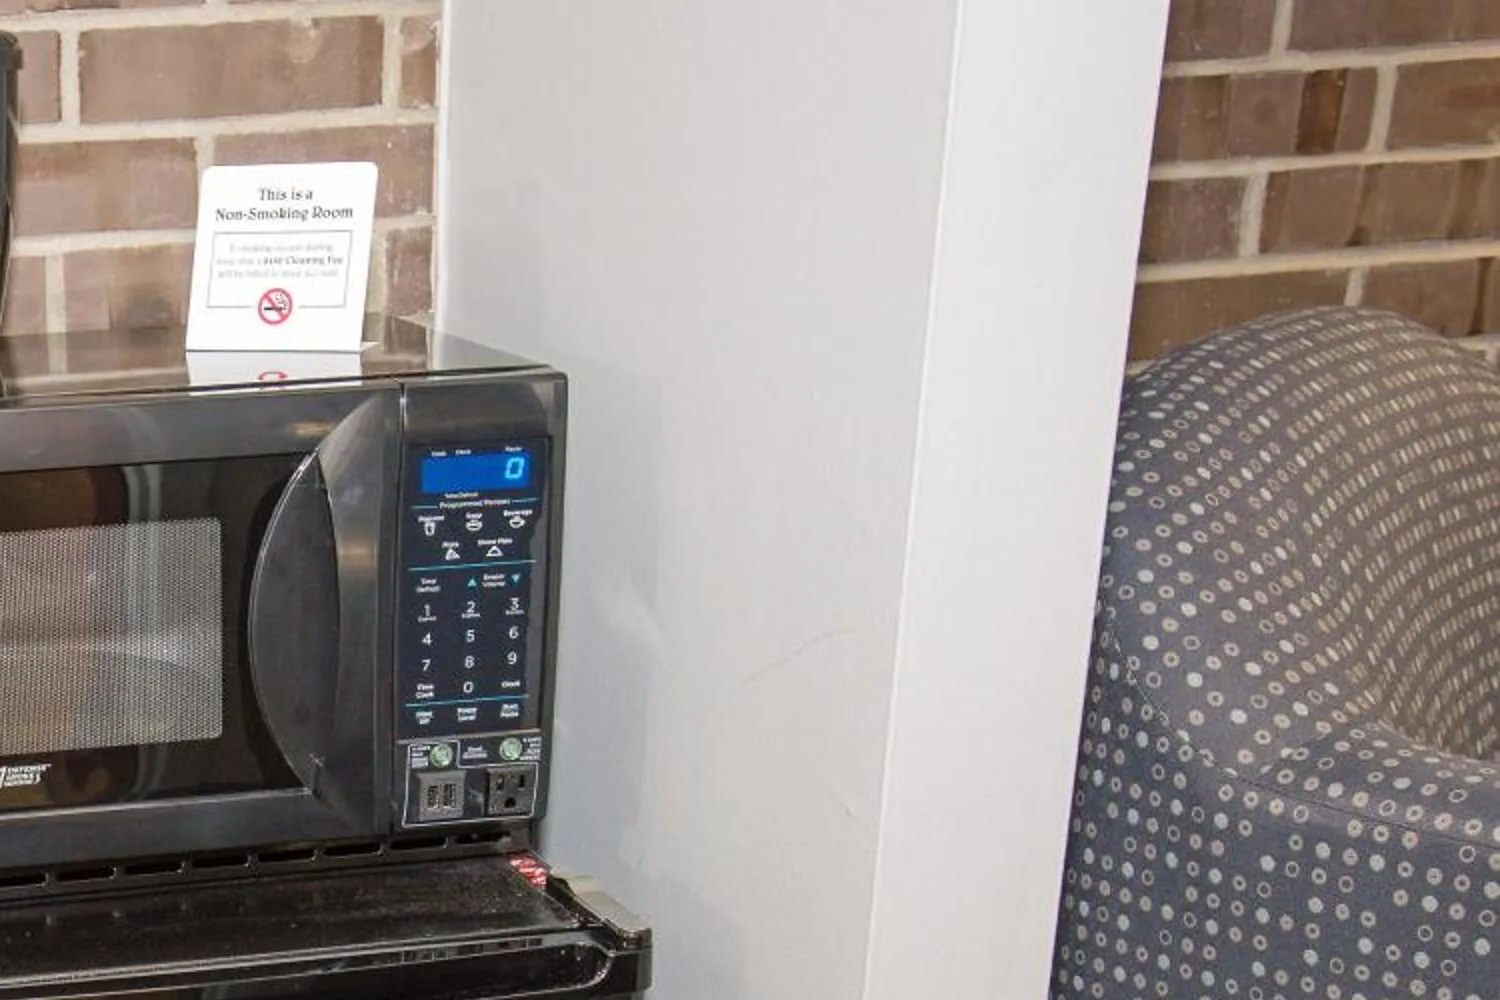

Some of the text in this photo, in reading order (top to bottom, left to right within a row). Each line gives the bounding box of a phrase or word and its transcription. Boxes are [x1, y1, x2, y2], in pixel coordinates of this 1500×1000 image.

[258, 187, 314, 201] This is a
[215, 205, 353, 222] Non-Smoking Room
[504, 456, 525, 480] 0
[424, 597, 519, 617] 1 2 3
[422, 625, 519, 646] 4 5 6
[421, 651, 517, 672] 7 8 9
[463, 681, 474, 693] 0
